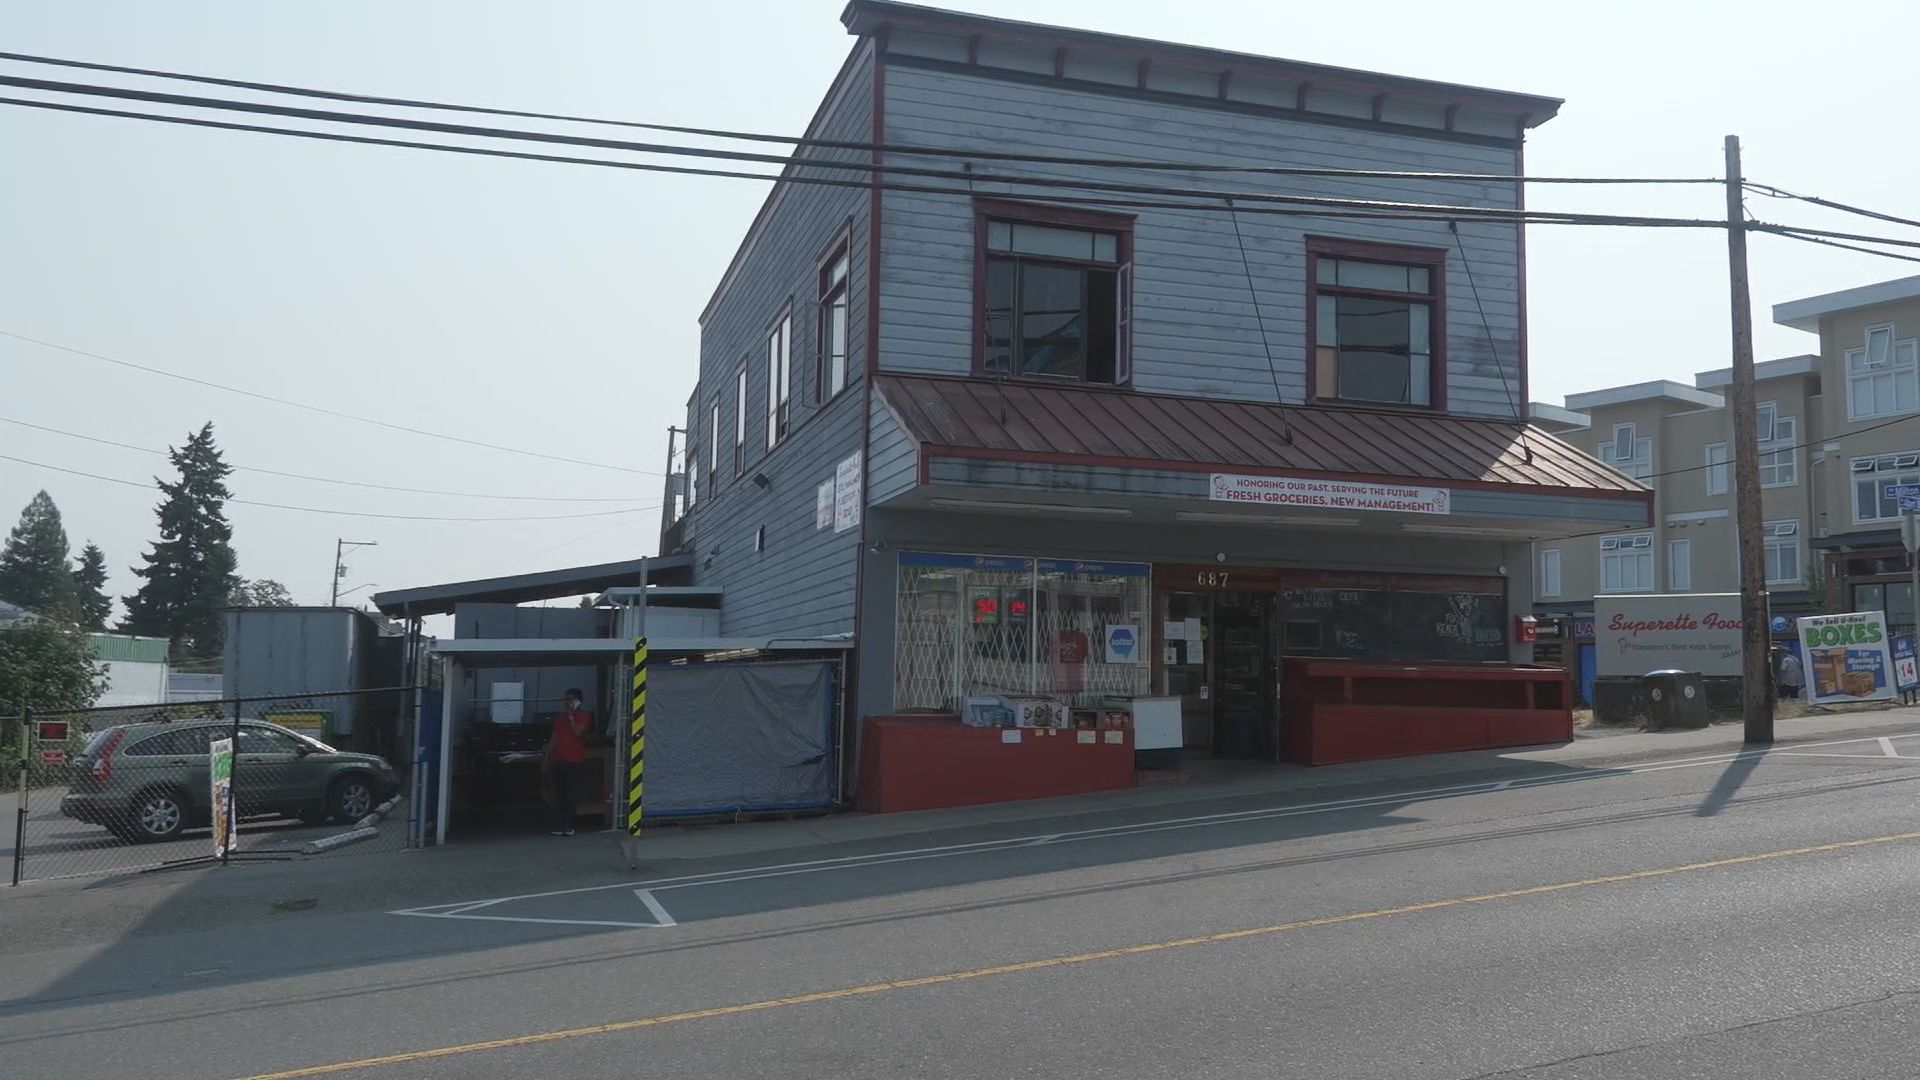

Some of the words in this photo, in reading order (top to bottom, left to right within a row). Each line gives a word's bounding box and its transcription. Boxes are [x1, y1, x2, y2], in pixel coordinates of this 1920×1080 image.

[1237, 479, 1285, 489] HONORING
[1287, 482, 1306, 490] OUR
[1331, 485, 1367, 494] SERVING
[1369, 487, 1385, 496] THE
[1387, 489, 1419, 498] FUTURE
[1226, 490, 1261, 501] FRESH
[1264, 493, 1328, 505] GROCERIES,
[1331, 497, 1355, 507] NEW
[1358, 499, 1434, 512] MANAGEMENT!
[1198, 571, 1229, 587] 687
[1608, 613, 1698, 637] Superette
[1826, 617, 1839, 625] Sell
[1805, 622, 1883, 647] BOXES
[1671, 643, 1687, 651] Best
[1689, 643, 1706, 652] Kept
[1708, 643, 1731, 651] Secret
[1901, 661, 1914, 678] 14
